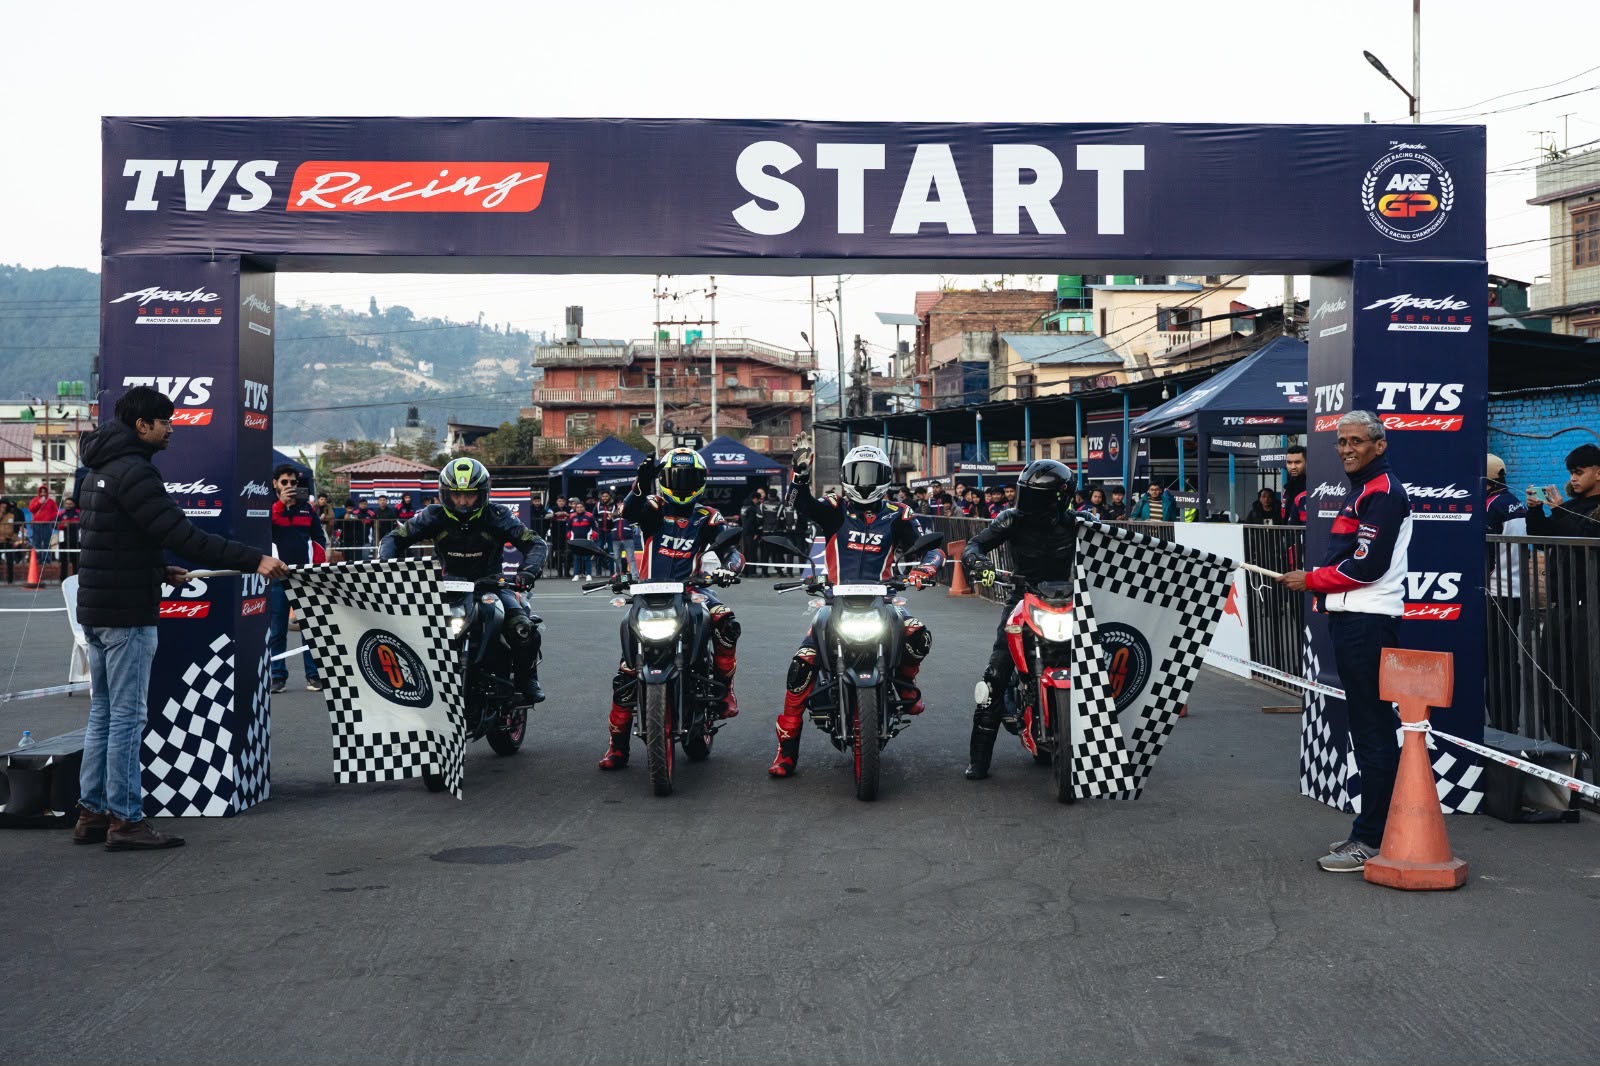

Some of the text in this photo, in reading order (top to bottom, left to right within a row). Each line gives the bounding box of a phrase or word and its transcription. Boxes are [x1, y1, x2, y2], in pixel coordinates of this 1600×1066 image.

[1373, 152, 1444, 175] APACHE RACING EXPERIENCE
[121, 159, 544, 212] TVS Racing
[731, 140, 1145, 236] START
[1378, 192, 1438, 218] GP
[1369, 211, 1446, 239] ULTIMATE RACING CHAMPIONSHIP
[109, 286, 222, 307] Apache
[242, 293, 271, 314] Apache
[1362, 293, 1471, 313] Apache
[138, 307, 223, 315] SERIES
[1312, 296, 1348, 321] Apache
[1390, 314, 1473, 323] SERIES
[244, 379, 269, 411] TVS
[1314, 382, 1345, 414] TVS
[1375, 381, 1464, 412] TVS
[169, 410, 213, 424] ing
[245, 413, 268, 428] Racing
[1222, 416, 1282, 426] TVS Racing
[1315, 417, 1342, 432] Racin
[1384, 416, 1462, 430] Racing
[1088, 436, 1104, 451] TVS
[597, 455, 632, 463] TVS
[711, 453, 746, 461] TVS
[163, 478, 222, 495] ache
[240, 480, 270, 499] Apache
[911, 480, 929, 488] RIDERS
[1310, 482, 1347, 500] Apache
[1401, 483, 1473, 500] pache
[177, 500, 222, 508] IES
[1411, 504, 1473, 512] RIES
[660, 533, 695, 551] TVS
[848, 530, 884, 545] TVS
[241, 572, 266, 597] TVS
[1405, 571, 1463, 601] VS
[241, 599, 266, 615] Racing
[1403, 605, 1461, 619] cing
